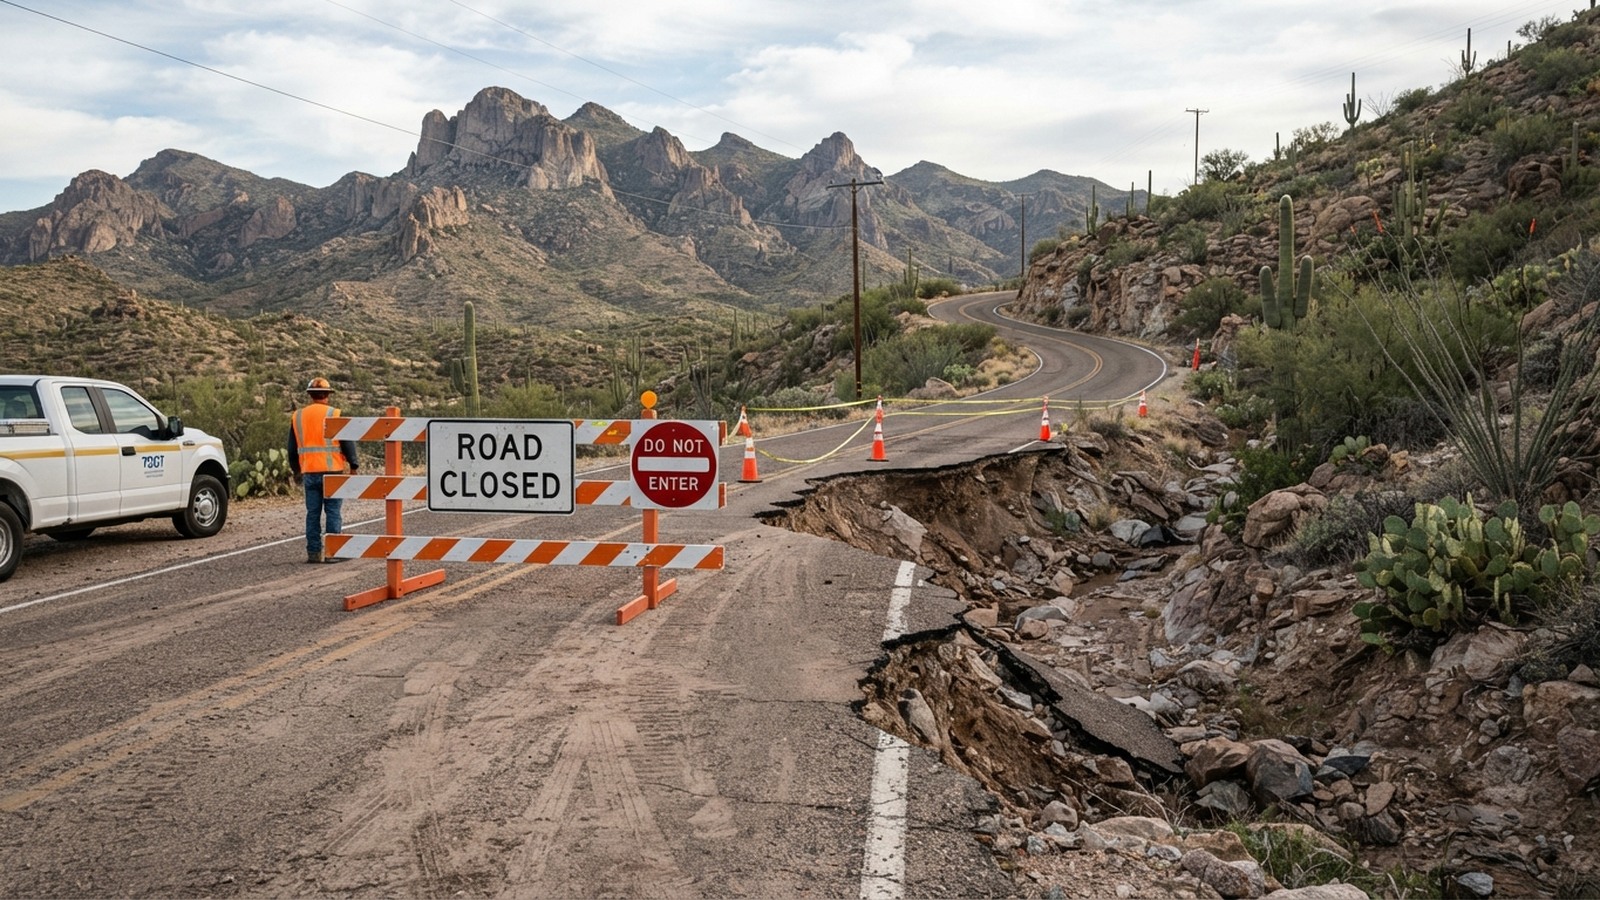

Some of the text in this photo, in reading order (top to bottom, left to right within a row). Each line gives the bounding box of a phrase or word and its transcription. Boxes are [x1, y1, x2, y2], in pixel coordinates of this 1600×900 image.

[457, 433, 543, 461] ROAD
[643, 438, 704, 454] DO NOT
[440, 470, 561, 499] CLOSED
[648, 476, 699, 491] ENTER
